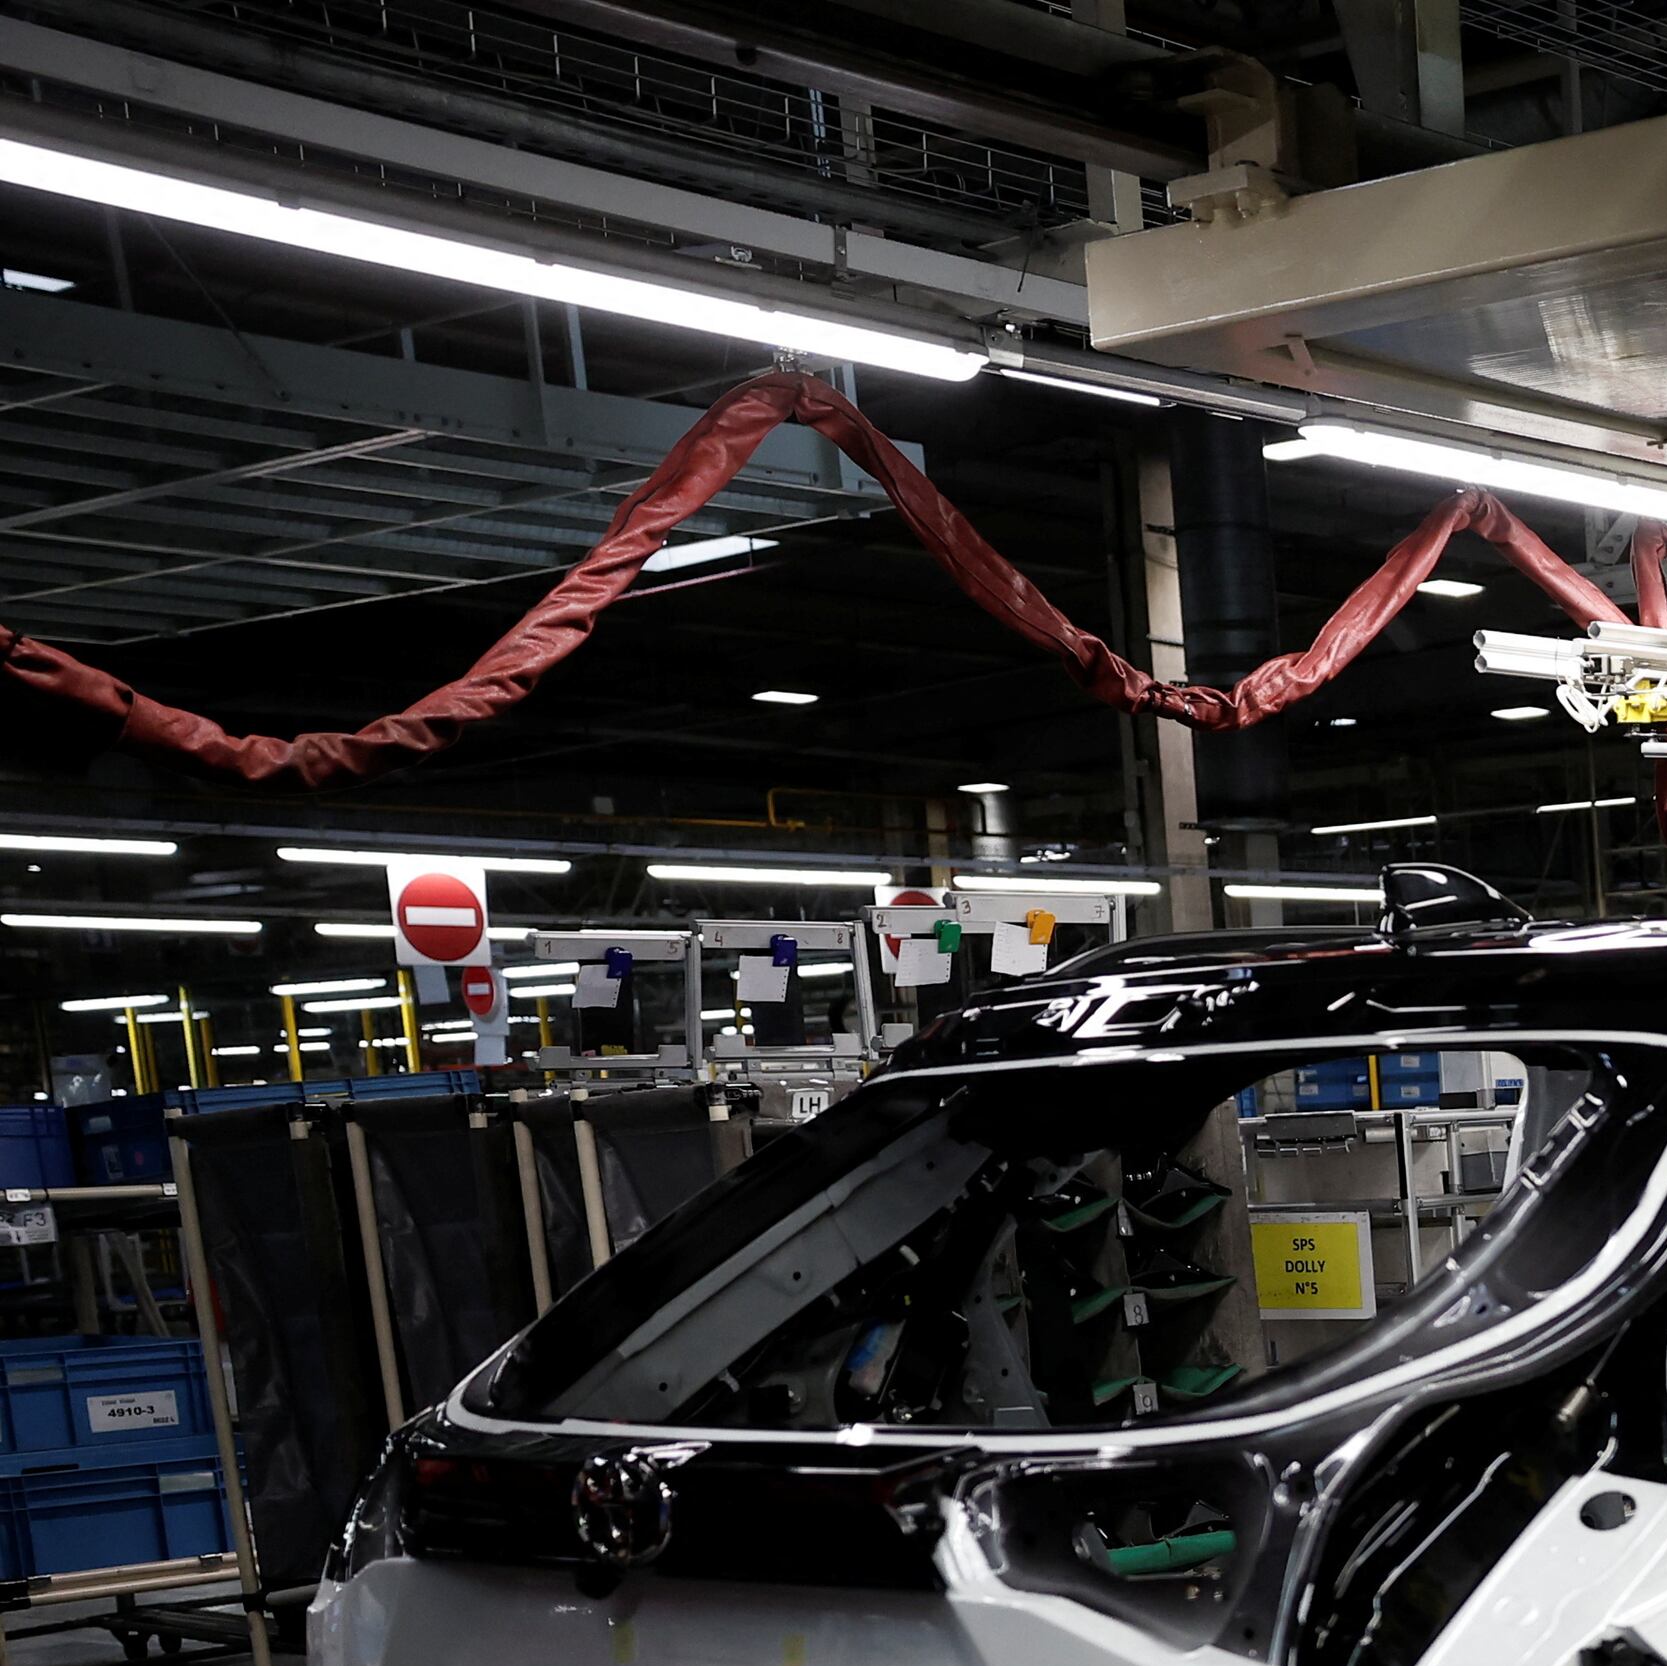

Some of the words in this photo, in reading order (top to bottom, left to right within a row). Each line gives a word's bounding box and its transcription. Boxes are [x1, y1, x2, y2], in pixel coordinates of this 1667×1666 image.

[961, 900, 972, 915] 3
[876, 913, 887, 928] 2
[714, 933, 724, 947] 4
[836, 932, 844, 945] 8
[544, 940, 552, 954] 1
[668, 940, 679, 954] 5
[799, 1097, 821, 1114] LH
[23, 1212, 47, 1227] F3
[1292, 1238, 1316, 1251] SPS
[1285, 1260, 1326, 1273] DOLLY
[1295, 1281, 1319, 1295] N°5
[1133, 1304, 1144, 1325] 8
[107, 1405, 156, 1418] 4910-3
